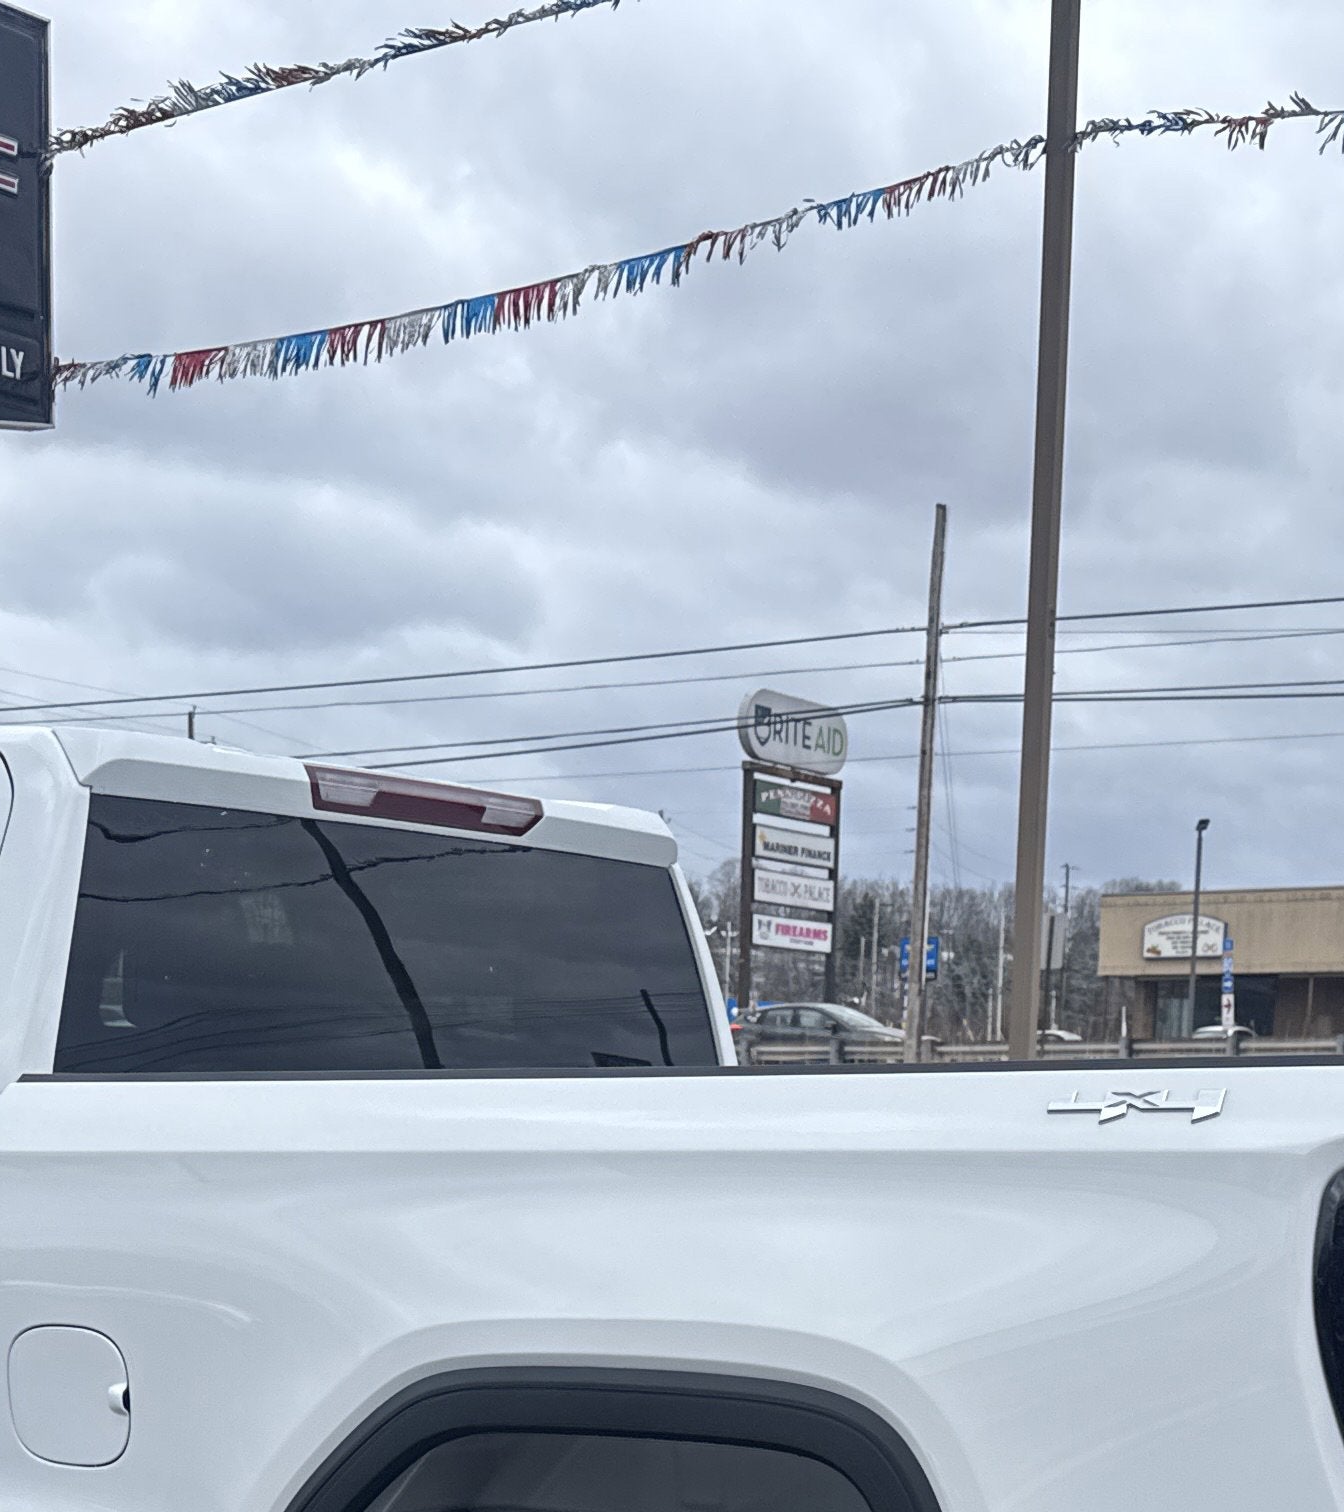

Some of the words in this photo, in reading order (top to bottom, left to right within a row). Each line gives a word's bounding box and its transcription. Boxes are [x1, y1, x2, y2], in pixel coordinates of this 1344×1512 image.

[772, 712, 812, 750] RITE
[815, 725, 845, 757] AID
[762, 840, 799, 857] MARINER
[775, 922, 829, 942] FIREARMS
